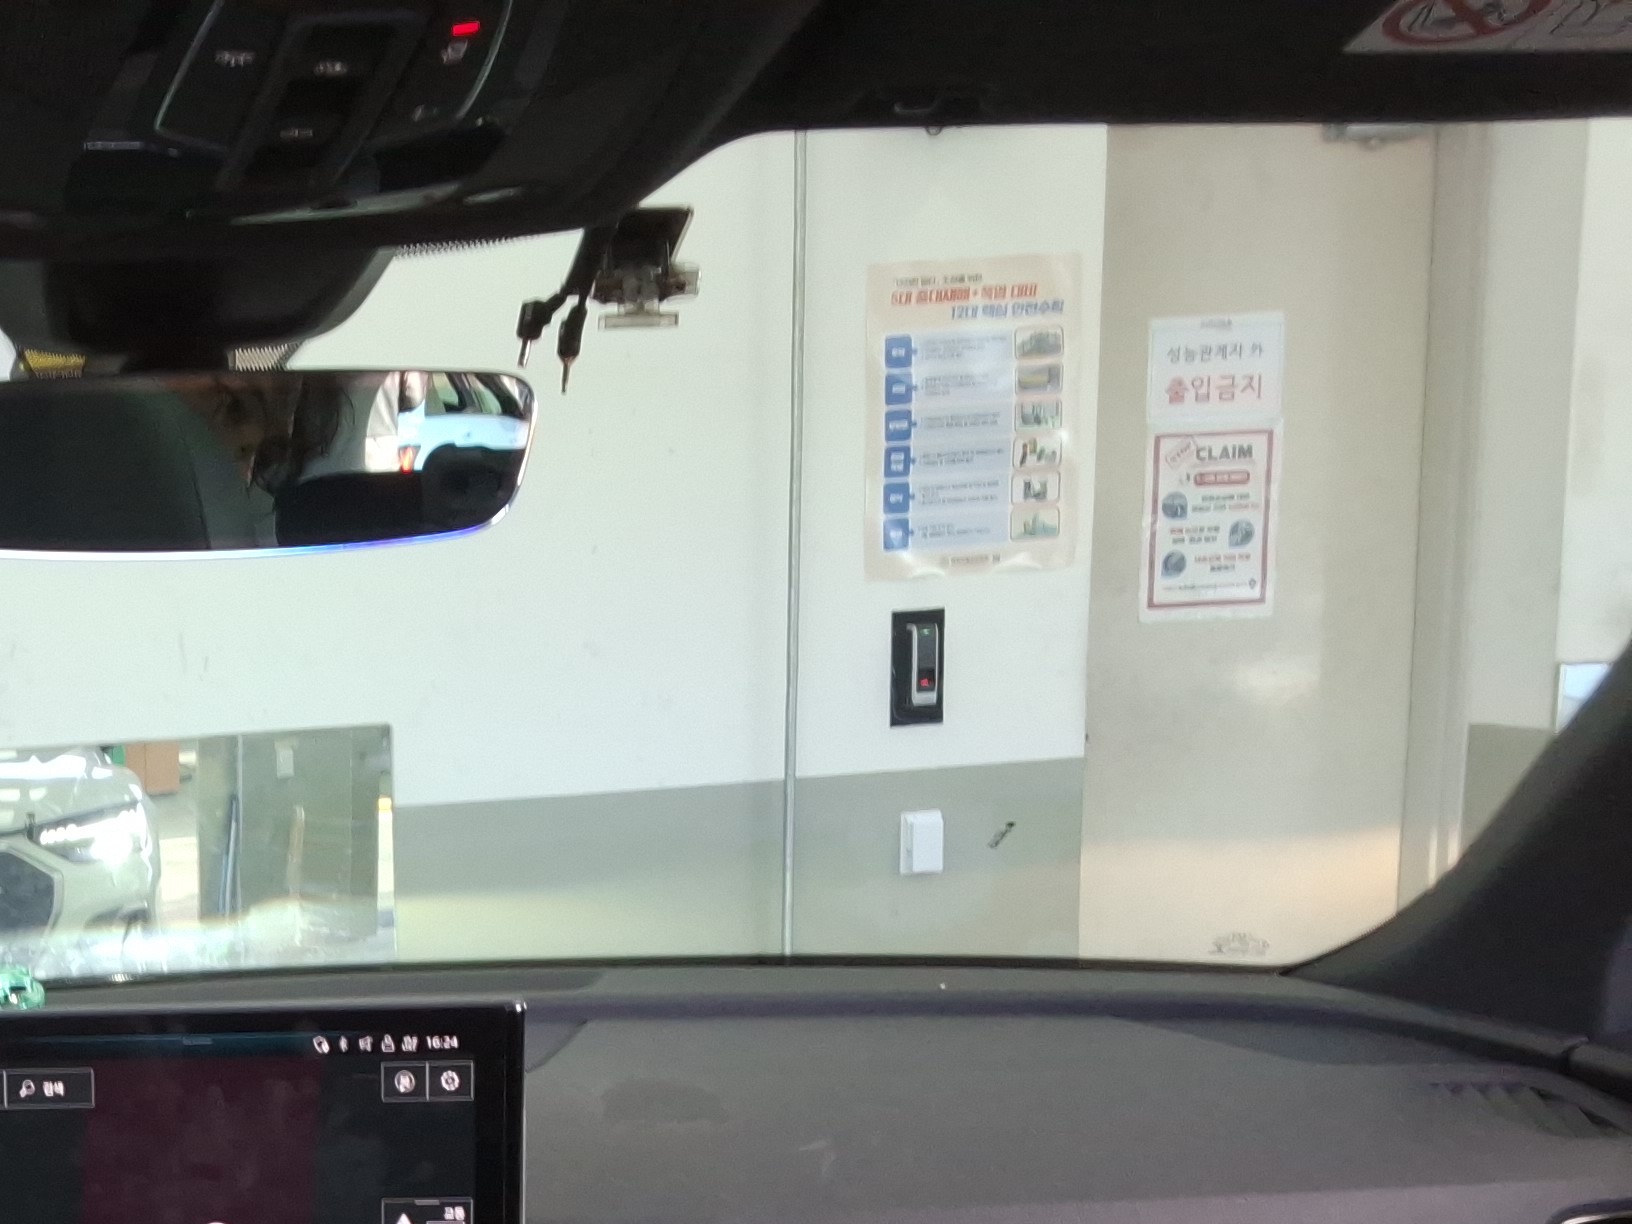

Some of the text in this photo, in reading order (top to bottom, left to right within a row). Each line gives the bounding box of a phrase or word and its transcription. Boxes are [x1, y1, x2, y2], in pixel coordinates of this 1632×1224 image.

[1165, 371, 1264, 405] 출입금지
[1195, 443, 1254, 462] CLAIM
[426, 1035, 459, 1049] 16:24
